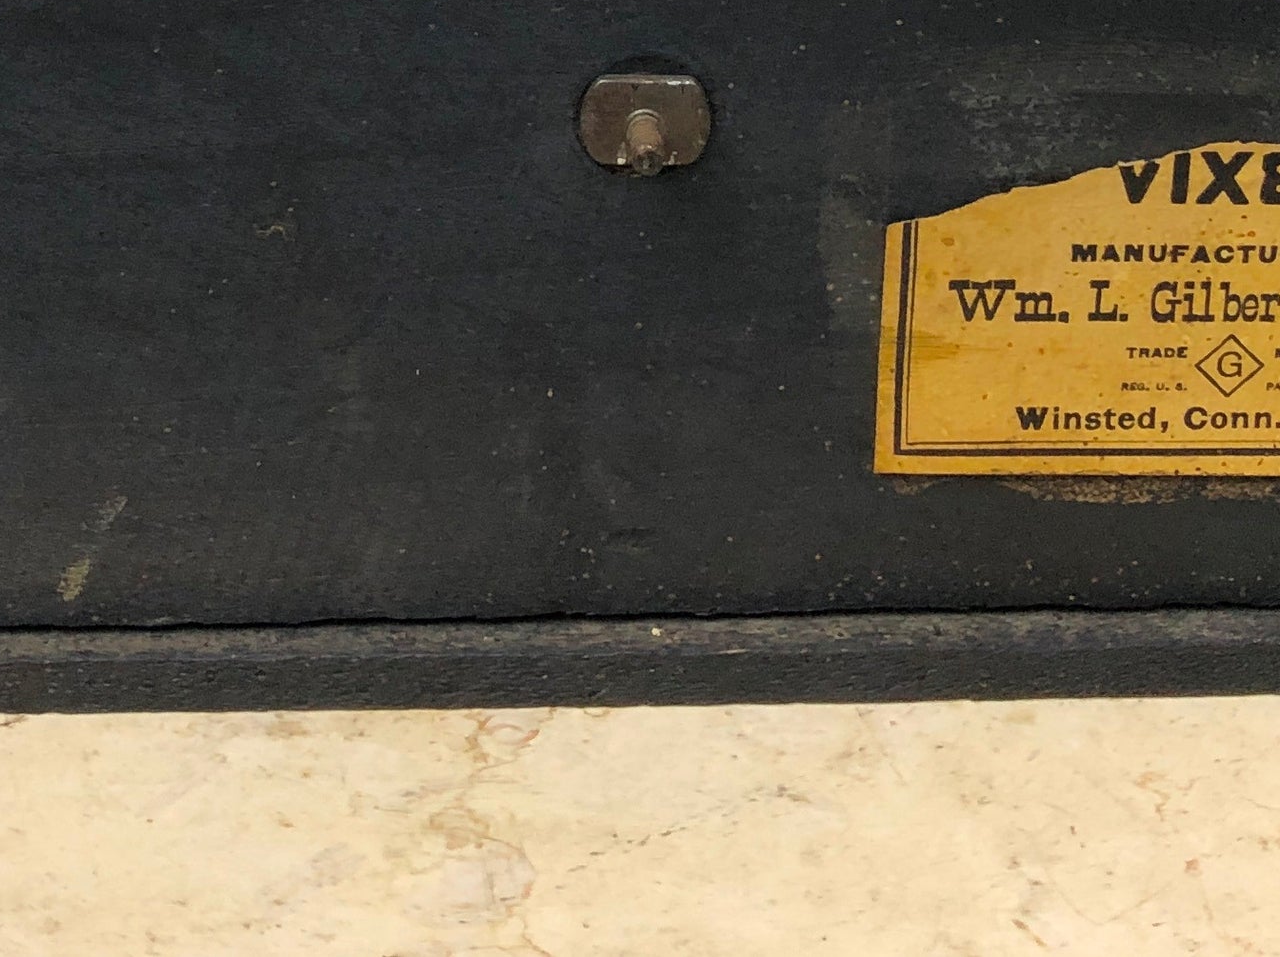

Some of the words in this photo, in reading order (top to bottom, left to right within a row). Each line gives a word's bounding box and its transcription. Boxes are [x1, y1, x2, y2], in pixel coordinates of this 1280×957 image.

[948, 279, 1070, 324] Wm.
[1087, 280, 1129, 323] L.
[1125, 346, 1189, 360] TRADE
[1216, 350, 1243, 379] G
[1120, 381, 1150, 392] REG.
[1155, 382, 1170, 392] U.
[1014, 405, 1169, 434] Winsted,
